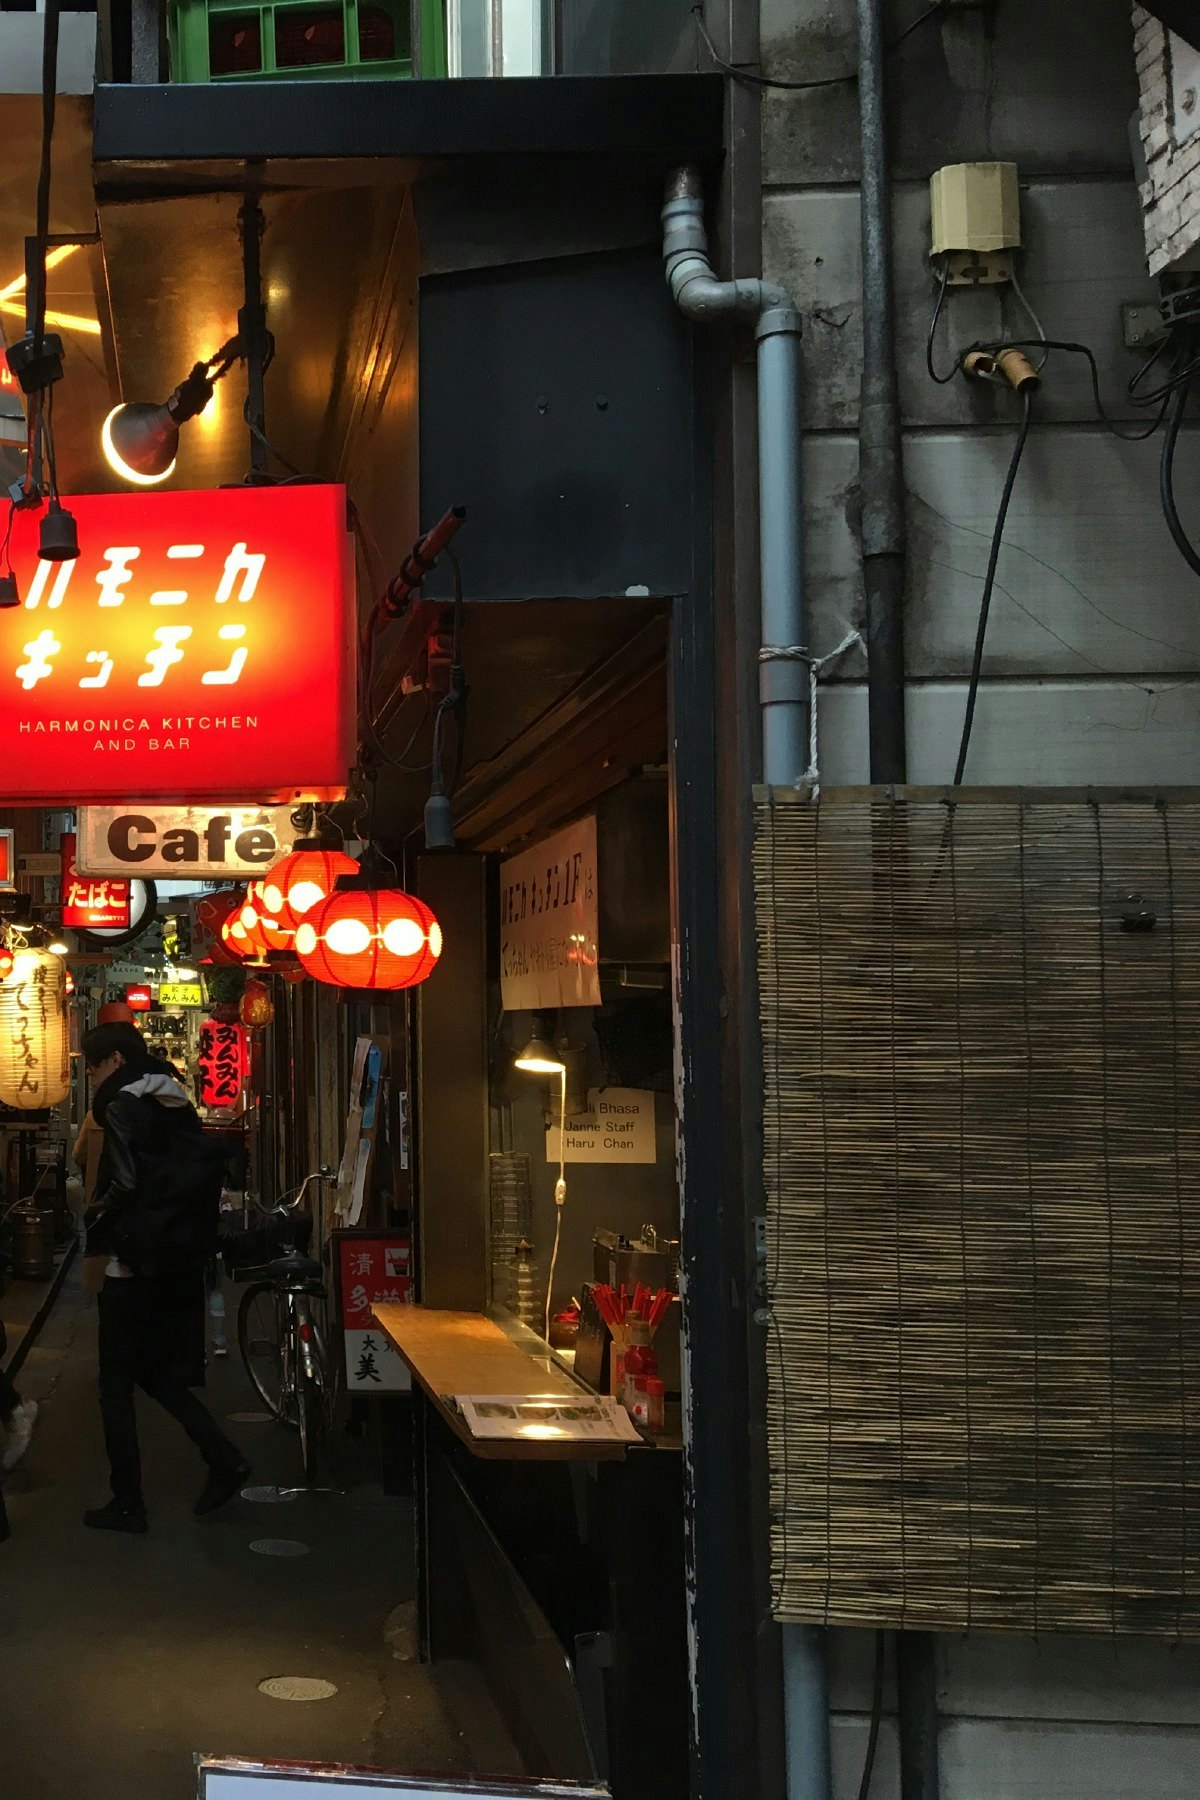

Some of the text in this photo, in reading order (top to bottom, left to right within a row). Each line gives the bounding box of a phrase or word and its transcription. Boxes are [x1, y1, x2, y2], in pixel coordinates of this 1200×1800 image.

[24, 541, 266, 610] ハモニカ
[14, 624, 249, 691] キッチン
[18, 715, 259, 734] HARMONICA KITCHEN
[93, 737, 191, 752] AND BAR
[107, 814, 276, 863] Café
[68, 880, 126, 908] たばこ
[161, 993, 199, 1004] みんみん
[215, 1026, 239, 1099] みんみん
[599, 1102, 640, 1114] Bhasa
[565, 1121, 636, 1132] Janne Staff
[566, 1137, 634, 1149] Haru Chan
